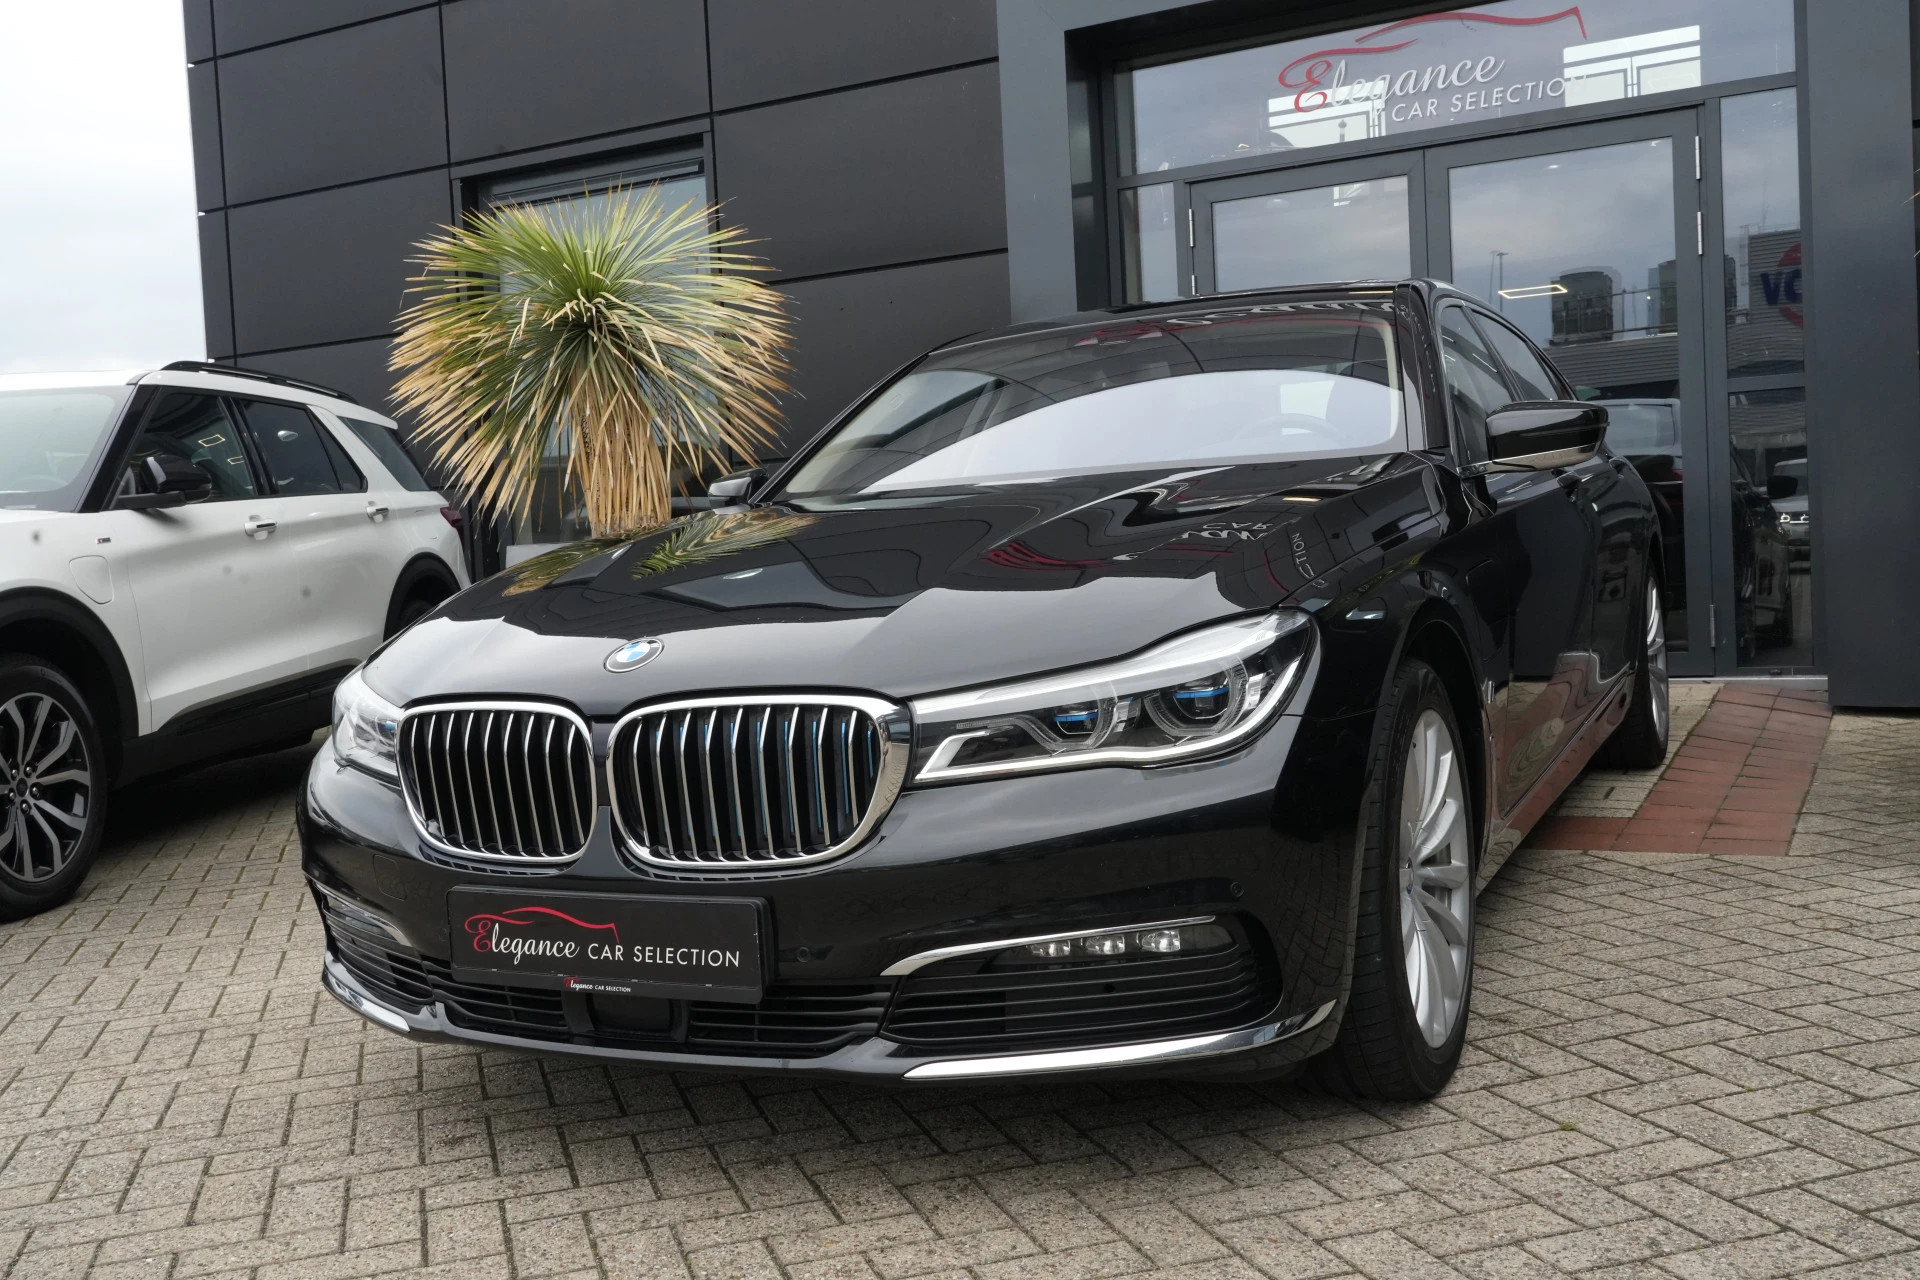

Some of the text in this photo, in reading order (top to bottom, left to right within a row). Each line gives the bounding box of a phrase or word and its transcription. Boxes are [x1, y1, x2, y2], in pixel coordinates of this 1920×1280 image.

[1278, 46, 1505, 119] Elegance
[1391, 98, 1438, 122] CAR
[464, 914, 740, 968] Elegance CAR SELECTION
[605, 985, 631, 993] SELECTION
